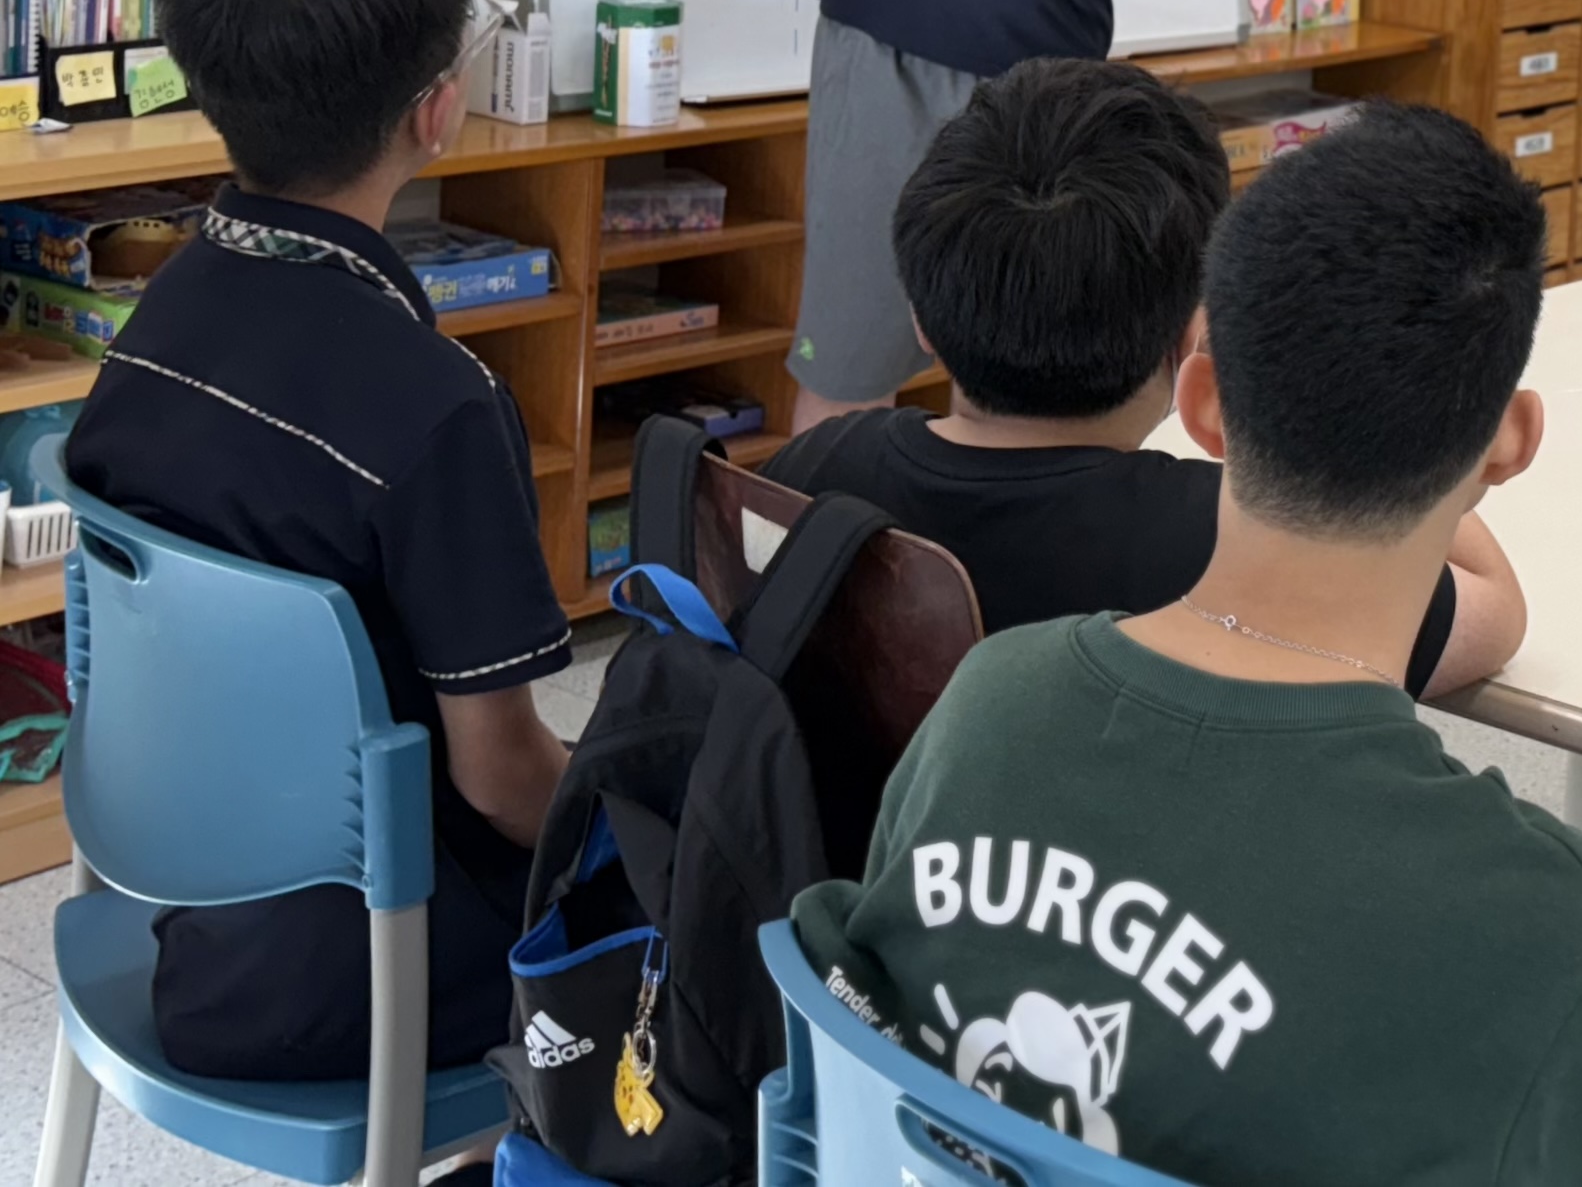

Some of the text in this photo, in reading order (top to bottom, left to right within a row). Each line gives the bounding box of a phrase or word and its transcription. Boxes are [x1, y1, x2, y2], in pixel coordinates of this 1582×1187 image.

[912, 836, 1274, 1071] BURGER
[825, 964, 881, 1026] Tender
[527, 1037, 595, 1069] adidas
